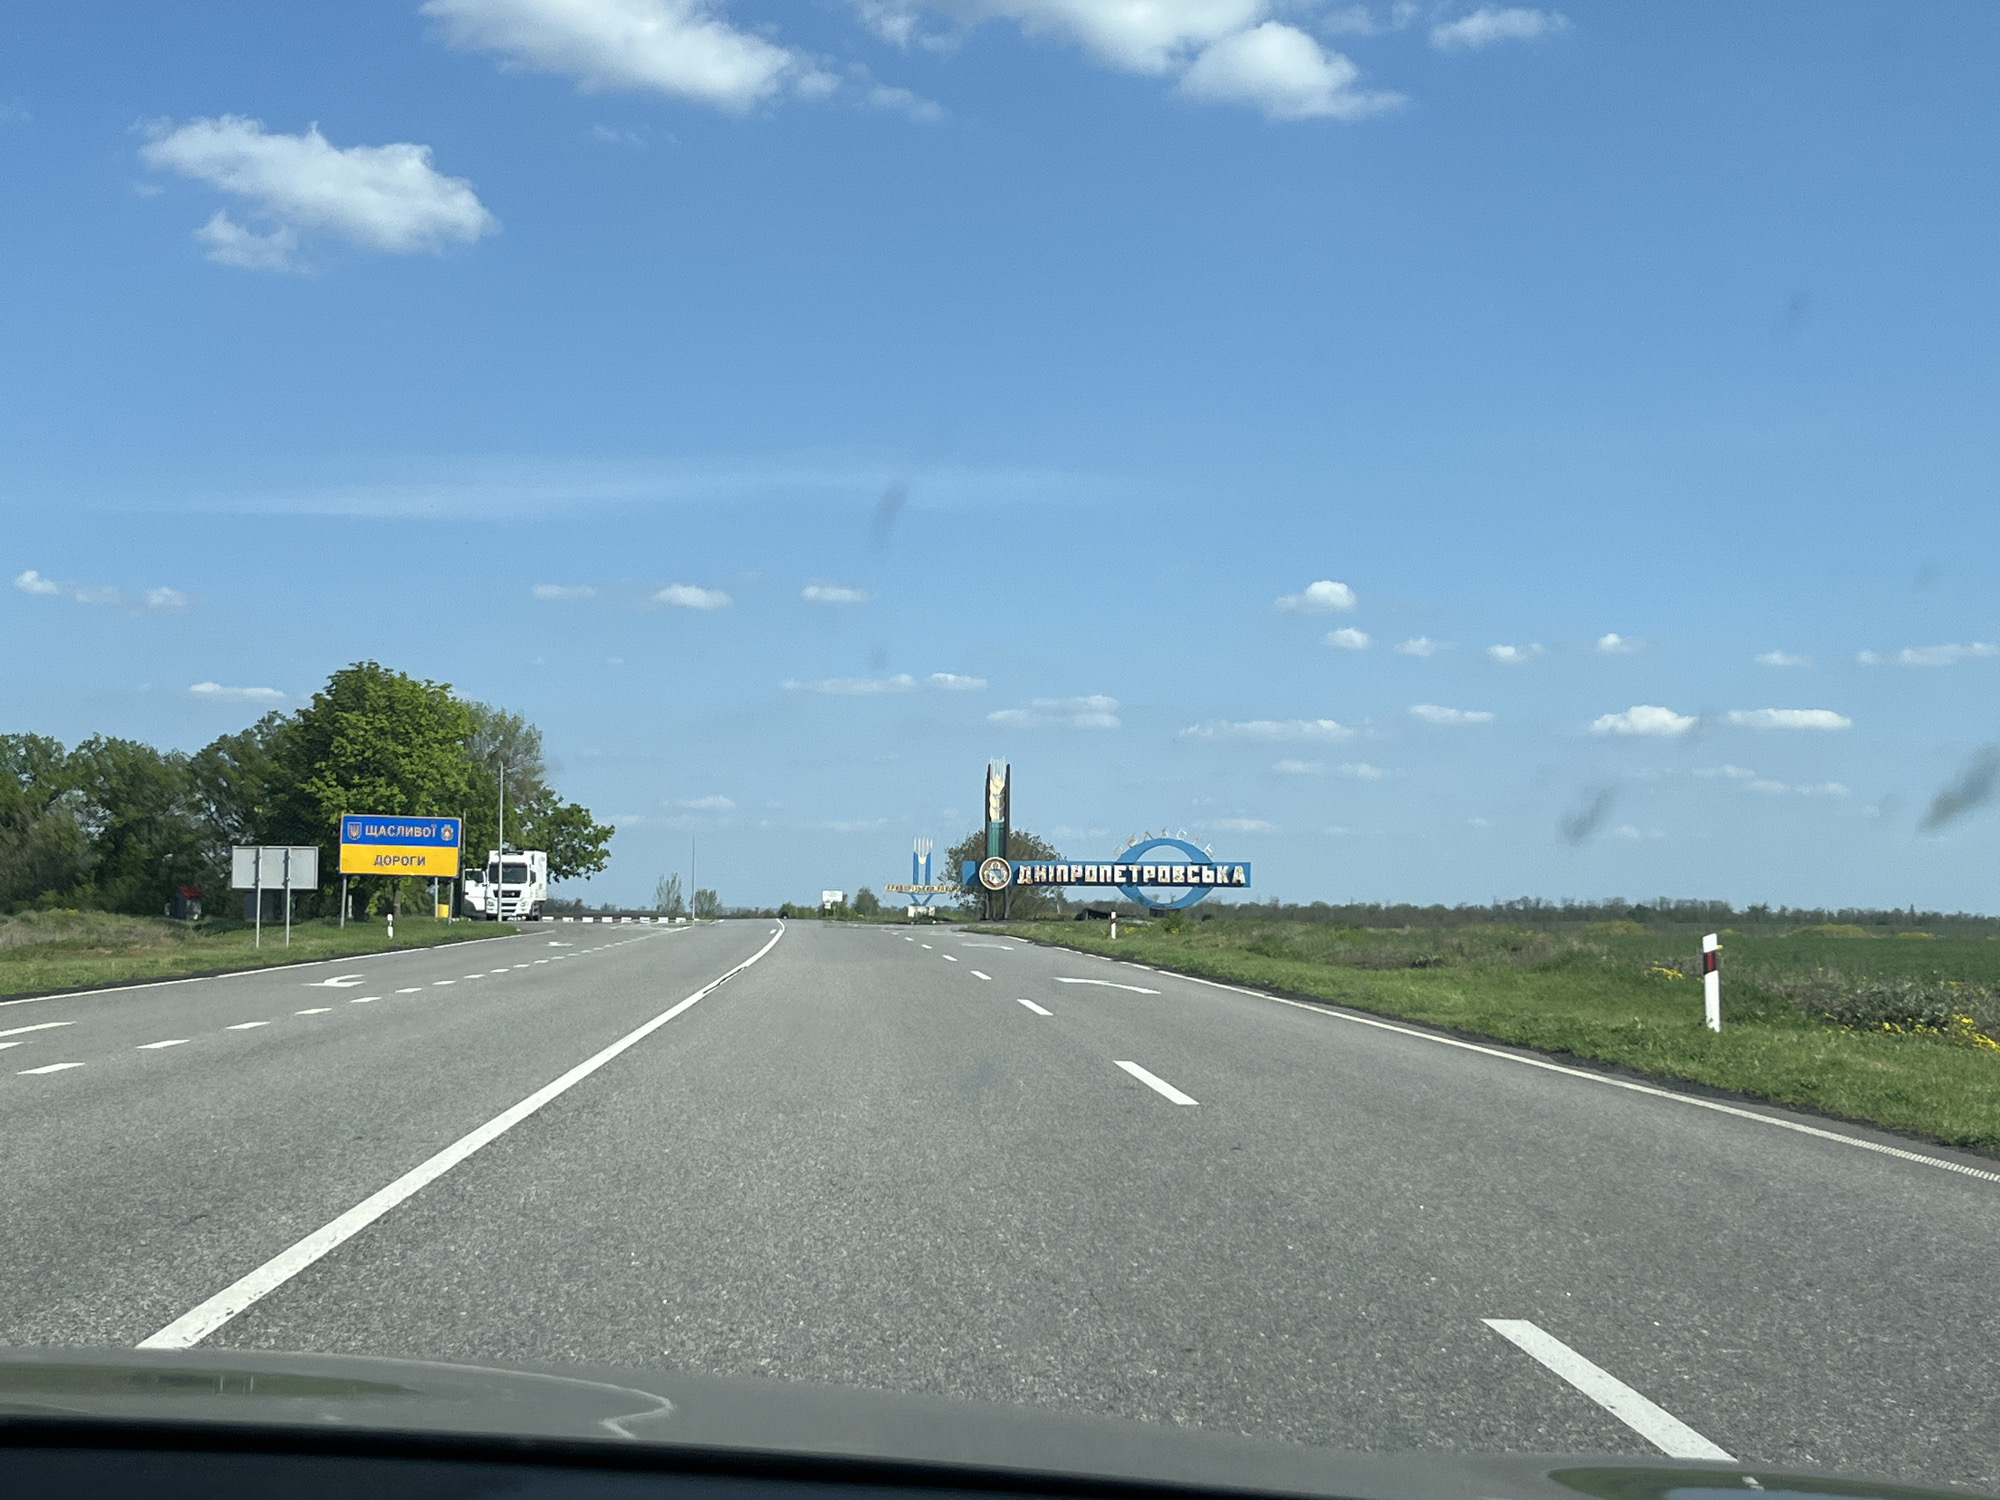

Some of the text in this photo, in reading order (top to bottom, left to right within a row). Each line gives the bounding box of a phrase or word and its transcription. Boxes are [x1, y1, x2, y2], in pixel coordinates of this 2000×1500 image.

[365, 823, 438, 838] ЩАСЛИВОЇ
[374, 854, 426, 866] ДОРОГИ
[1017, 864, 1246, 885] ДНІПРОПЕТРОВСЬКА
